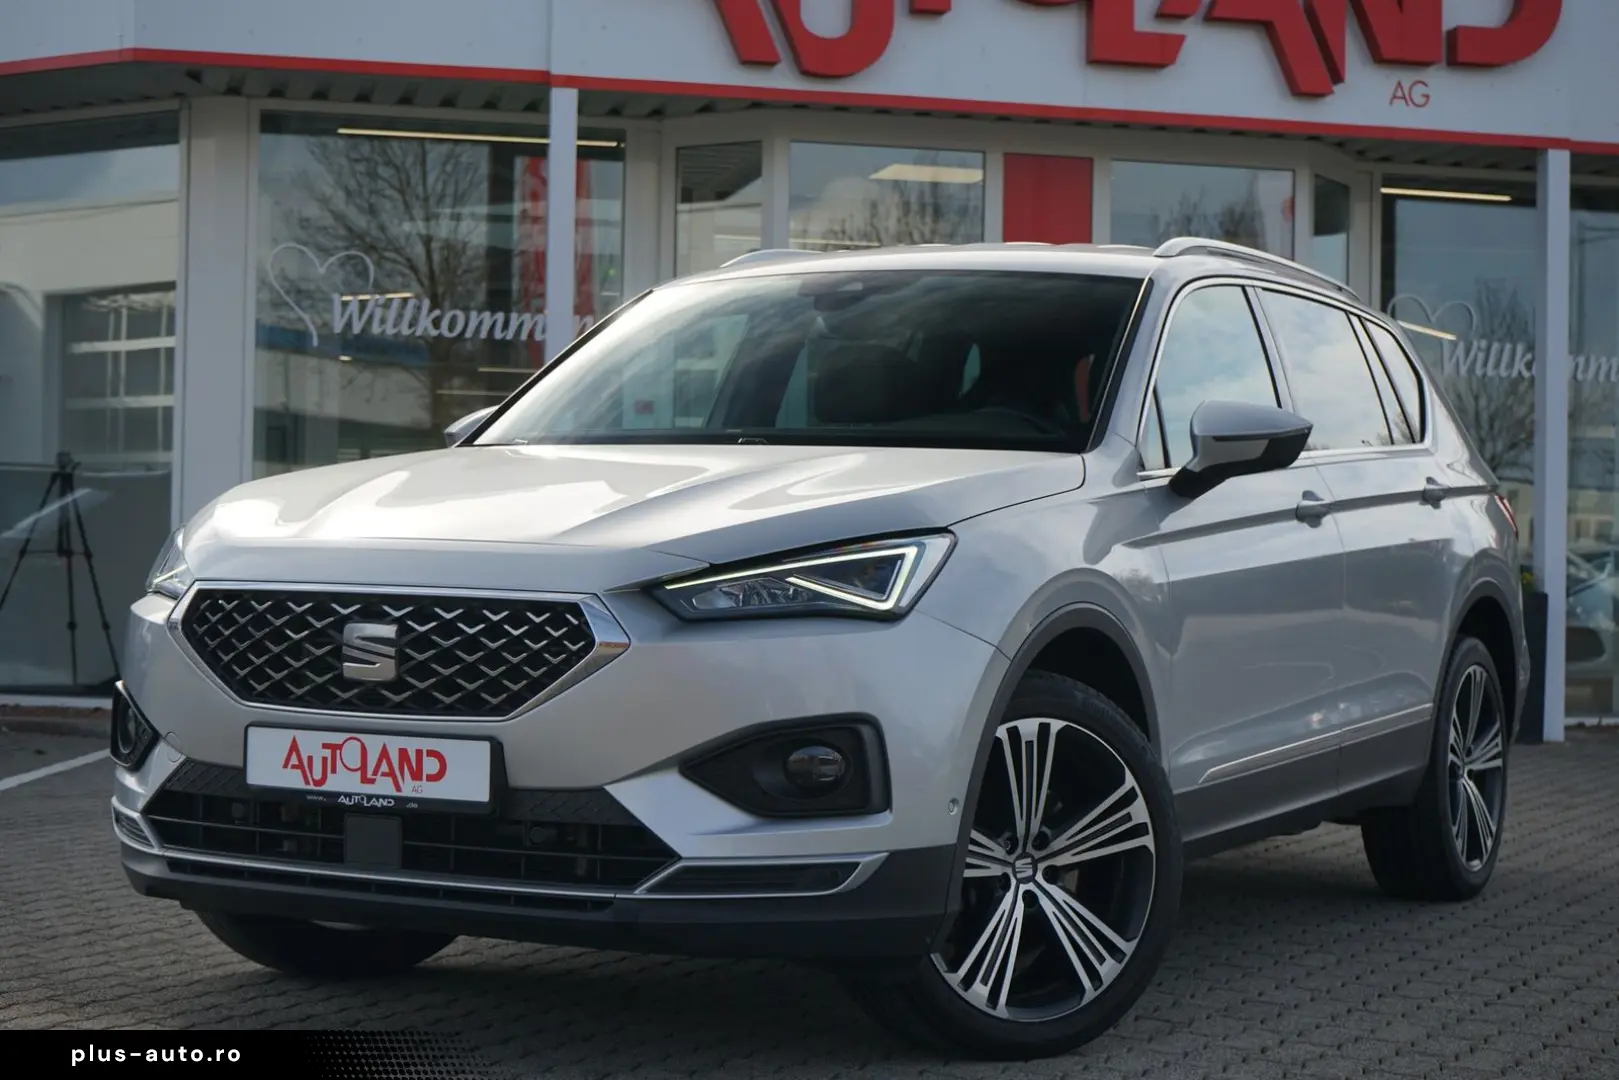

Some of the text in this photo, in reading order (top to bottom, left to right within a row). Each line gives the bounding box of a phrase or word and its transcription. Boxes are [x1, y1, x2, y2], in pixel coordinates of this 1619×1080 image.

[1389, 80, 1431, 108] AG
[333, 293, 595, 341] Willkommn
[282, 735, 447, 793] AUTOLAND
[411, 785, 424, 794] AG
